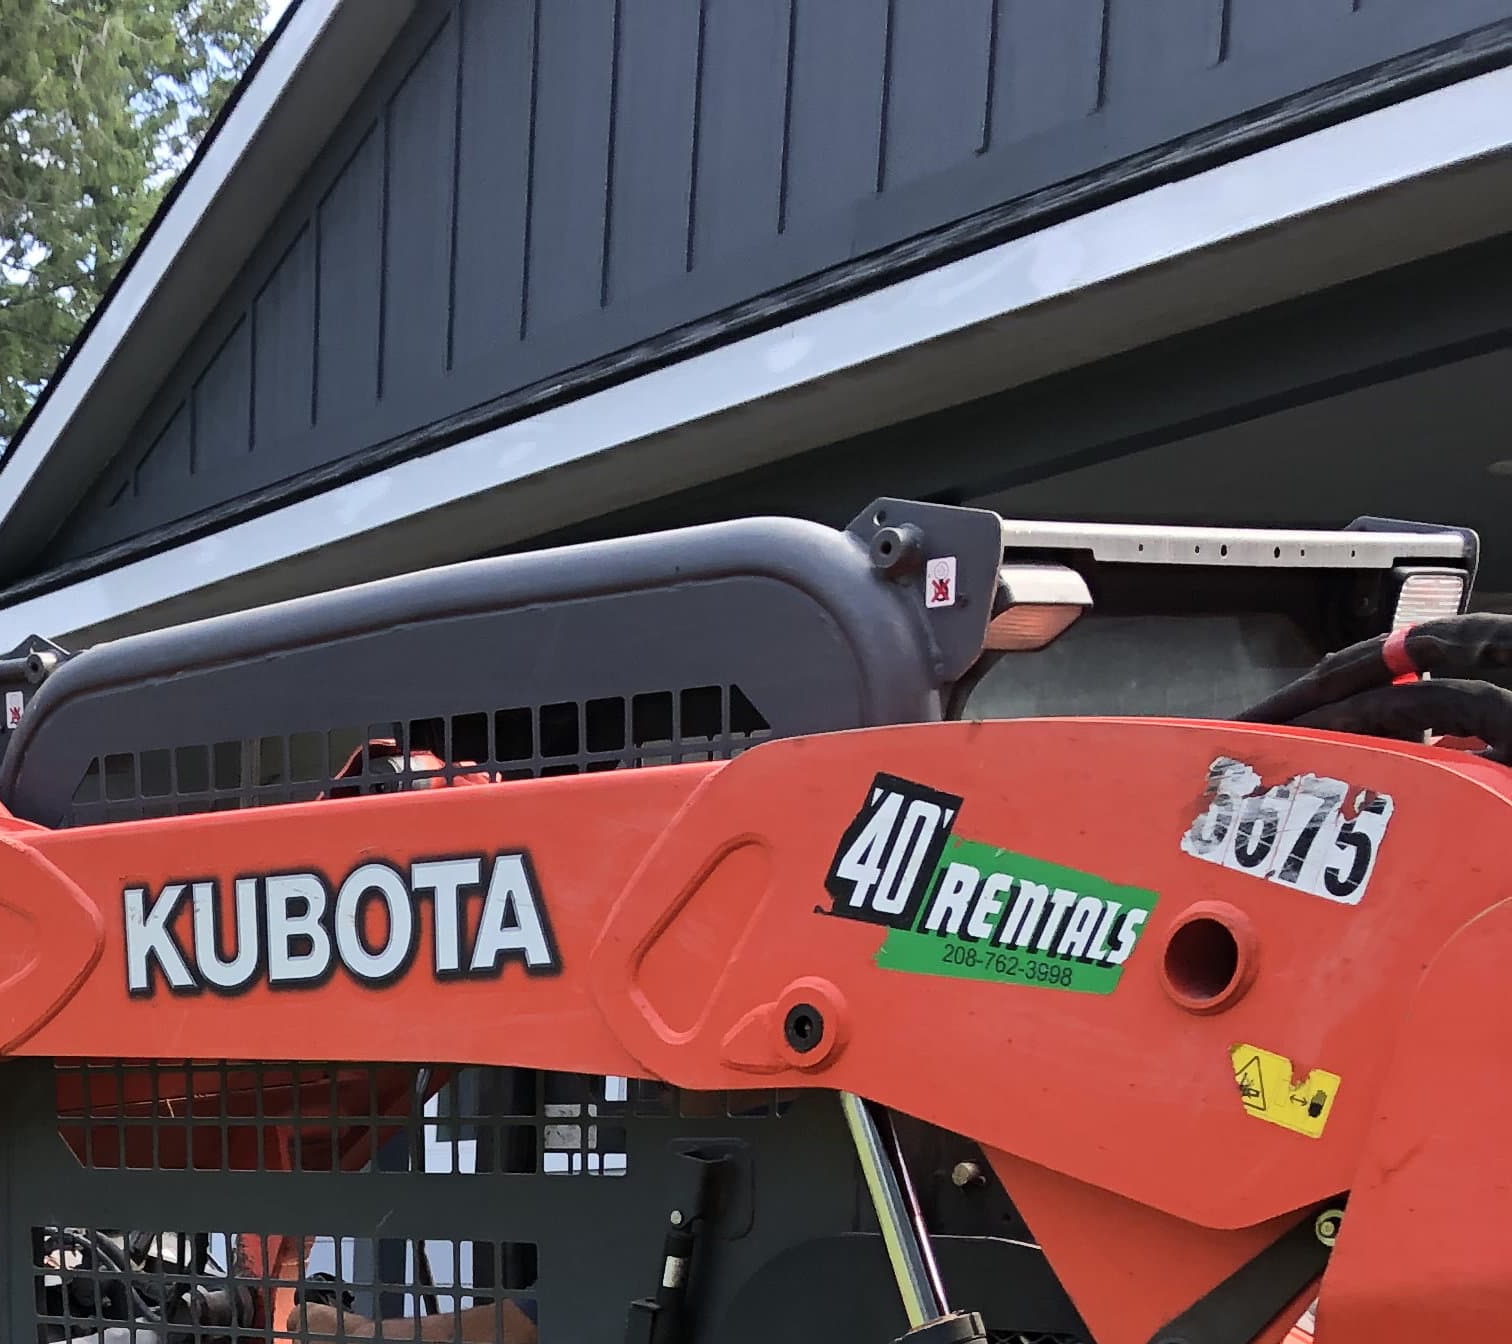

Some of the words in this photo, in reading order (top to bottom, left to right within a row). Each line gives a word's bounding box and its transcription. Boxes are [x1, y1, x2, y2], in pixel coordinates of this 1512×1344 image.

[122, 853, 558, 995] KUBOTA
[922, 861, 1149, 966] RENTALS
[942, 943, 1074, 988] 208-762-3998
